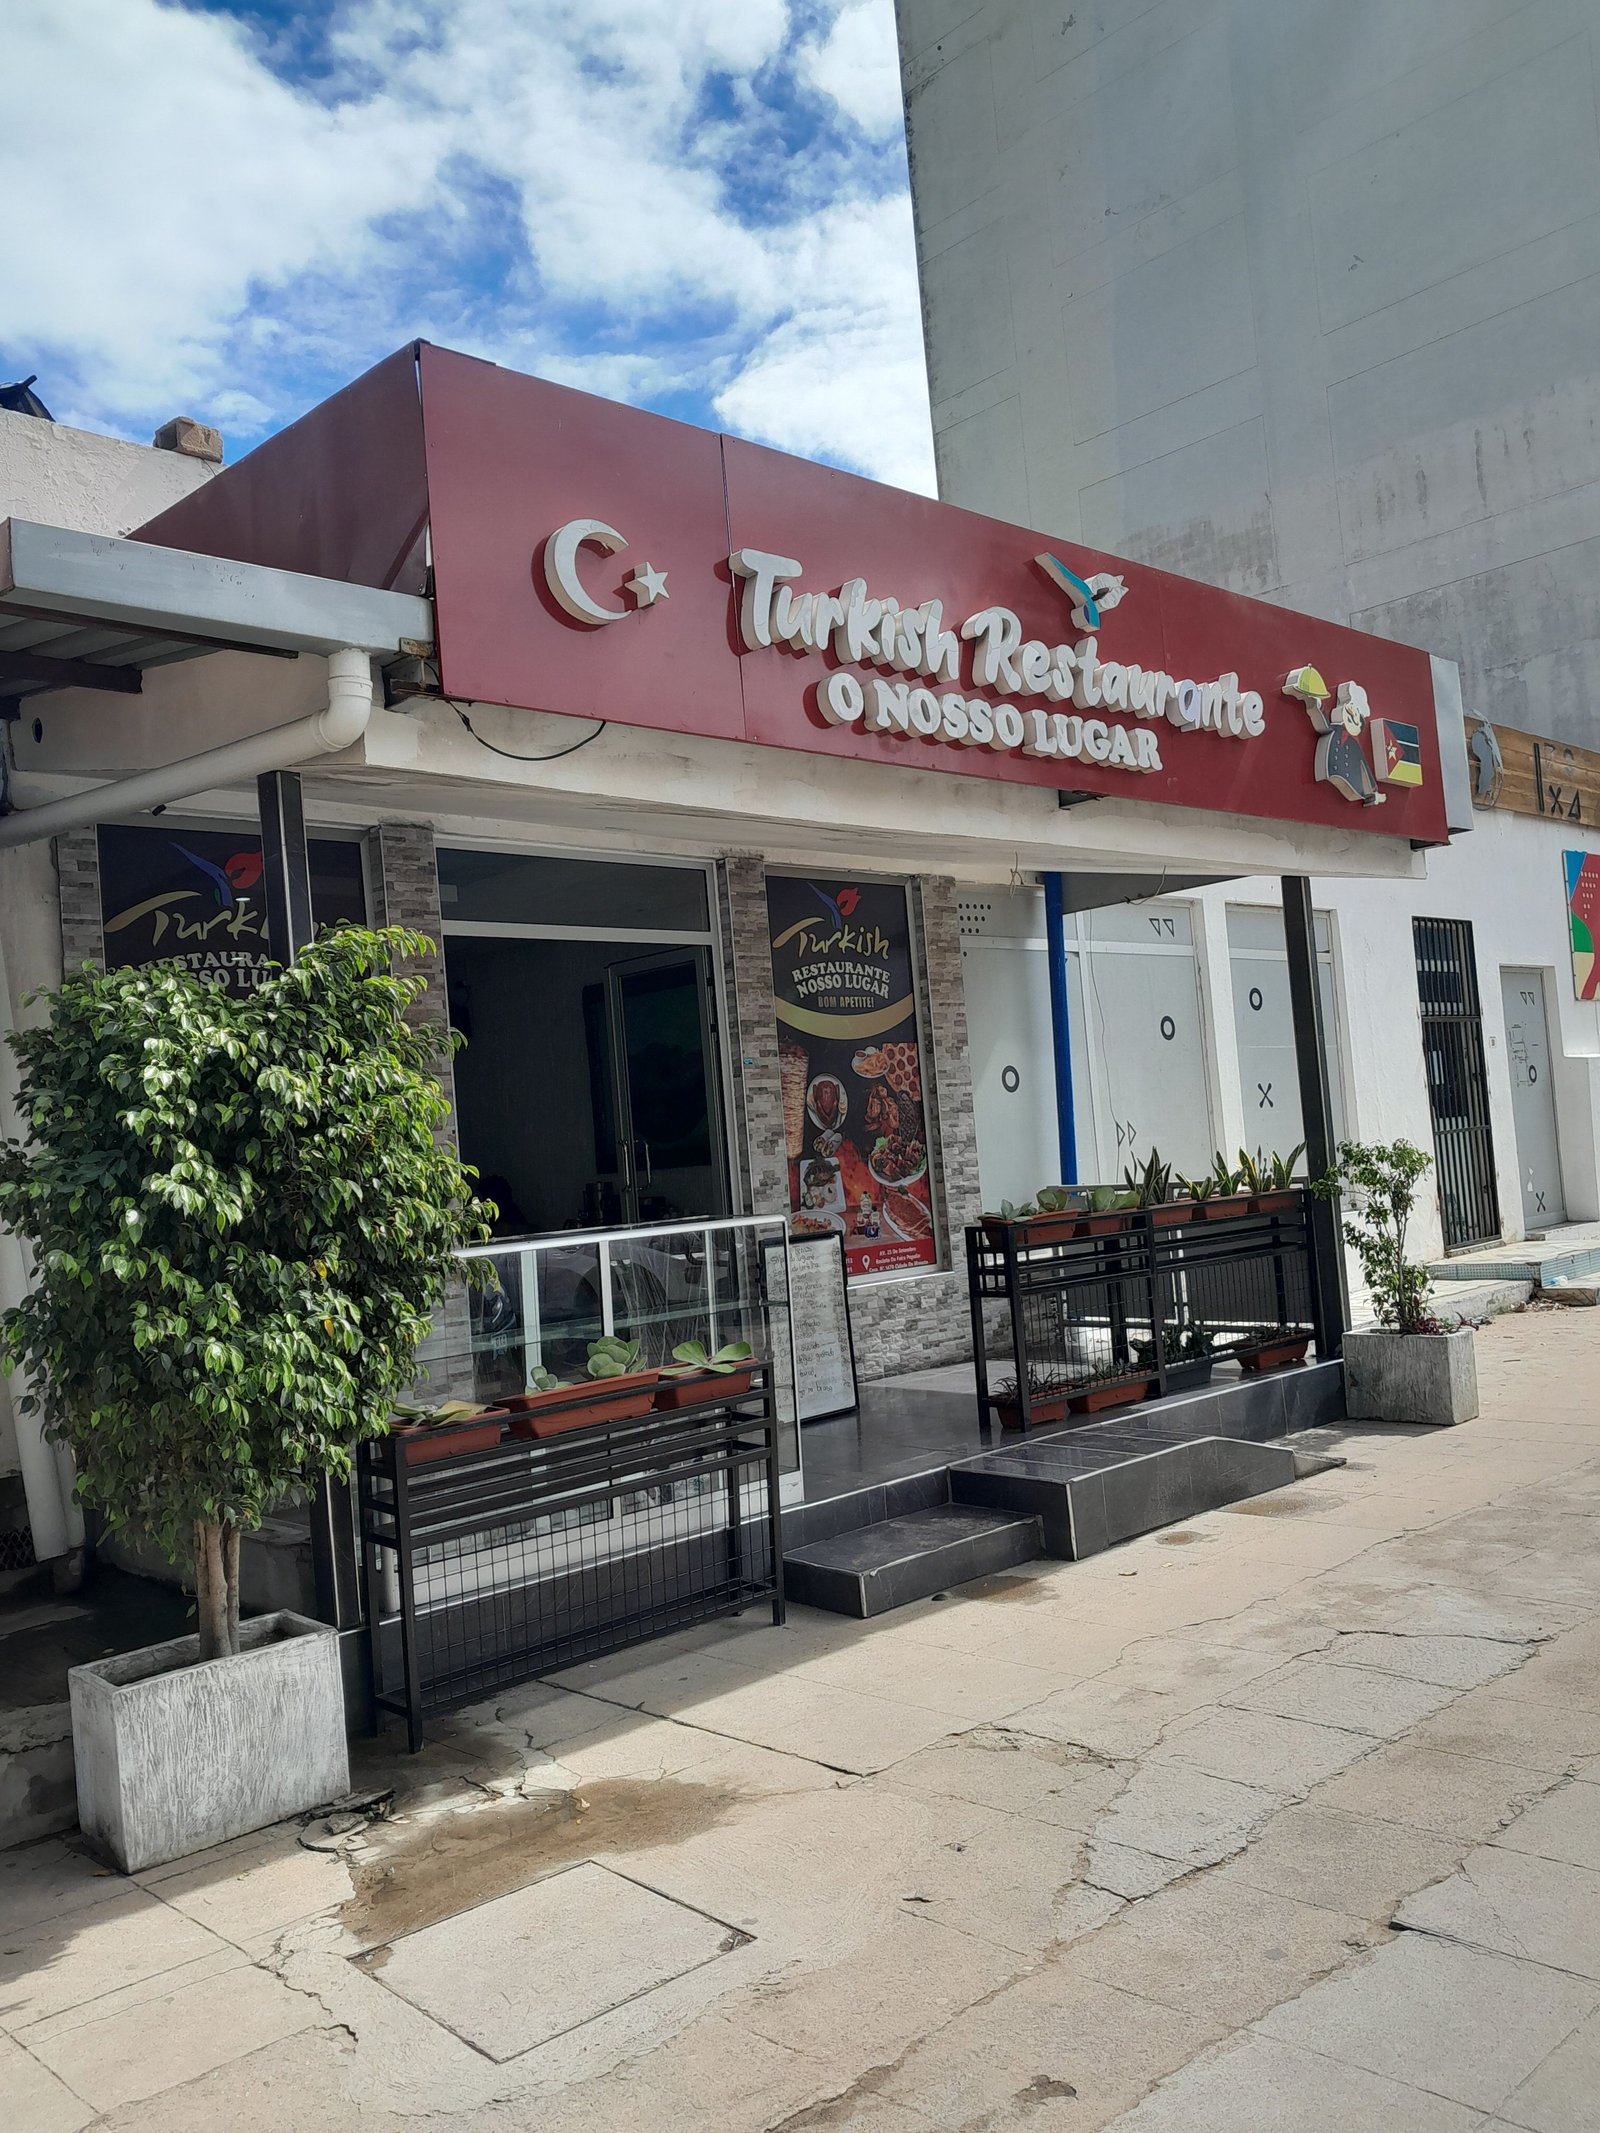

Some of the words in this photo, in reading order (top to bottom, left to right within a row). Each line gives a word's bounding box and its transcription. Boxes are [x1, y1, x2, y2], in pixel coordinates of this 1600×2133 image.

[729, 548, 959, 683] Turkish
[962, 606, 1266, 739] Restaurante
[817, 672, 863, 726] O
[864, 678, 1024, 750] NOSSO
[1023, 709, 1163, 774] LUGAR
[772, 916, 889, 960] Turkish
[792, 961, 890, 983] RESTAURANTE
[796, 974, 842, 998] NOSSO
[844, 974, 889, 999] LUGAR
[818, 996, 836, 1008] BOM
[840, 996, 875, 1008] APETITE!
